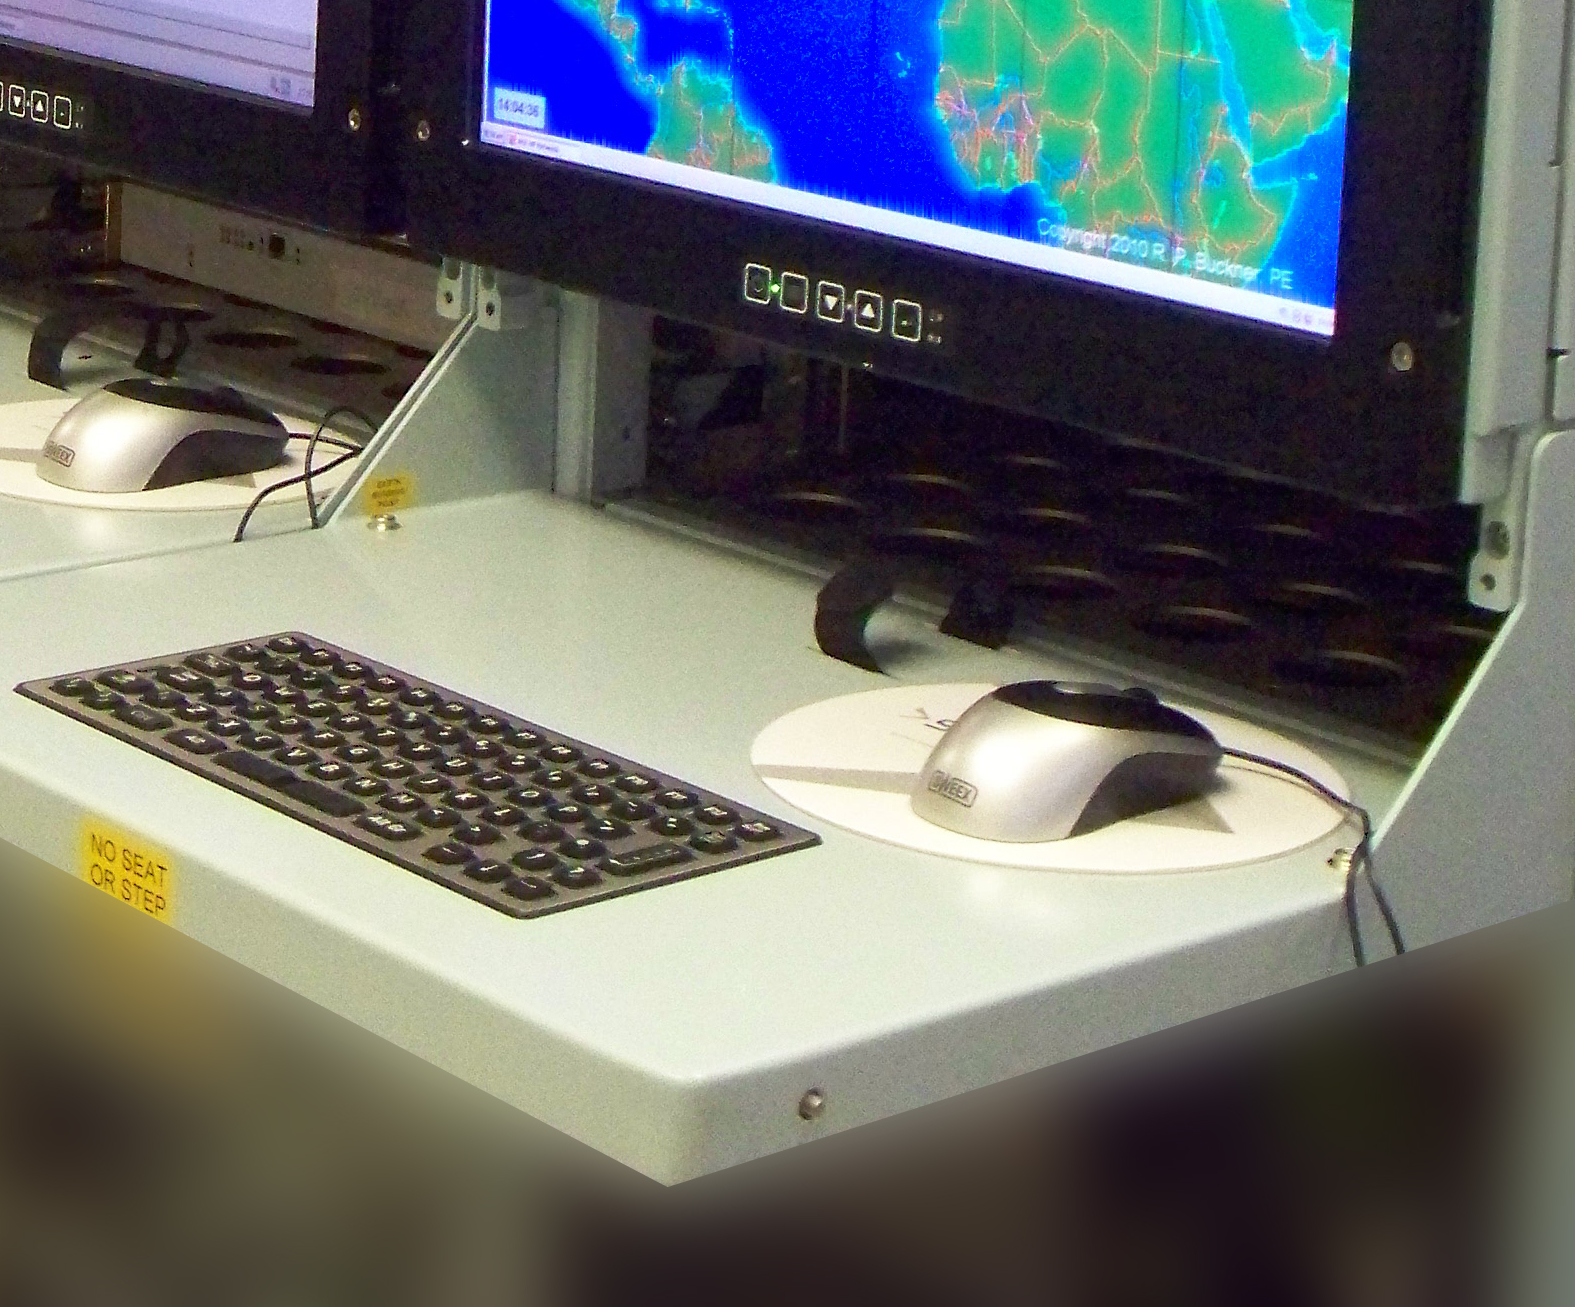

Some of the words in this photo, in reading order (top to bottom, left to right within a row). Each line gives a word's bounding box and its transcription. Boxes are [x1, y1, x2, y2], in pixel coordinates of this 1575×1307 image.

[1037, 218, 1108, 258] Copyright
[1110, 235, 1148, 258] 2010
[1270, 268, 1294, 289] PE
[91, 834, 116, 862] NO
[122, 848, 167, 888] SEAT
[90, 863, 115, 894] OR
[121, 878, 166, 915] STEP
